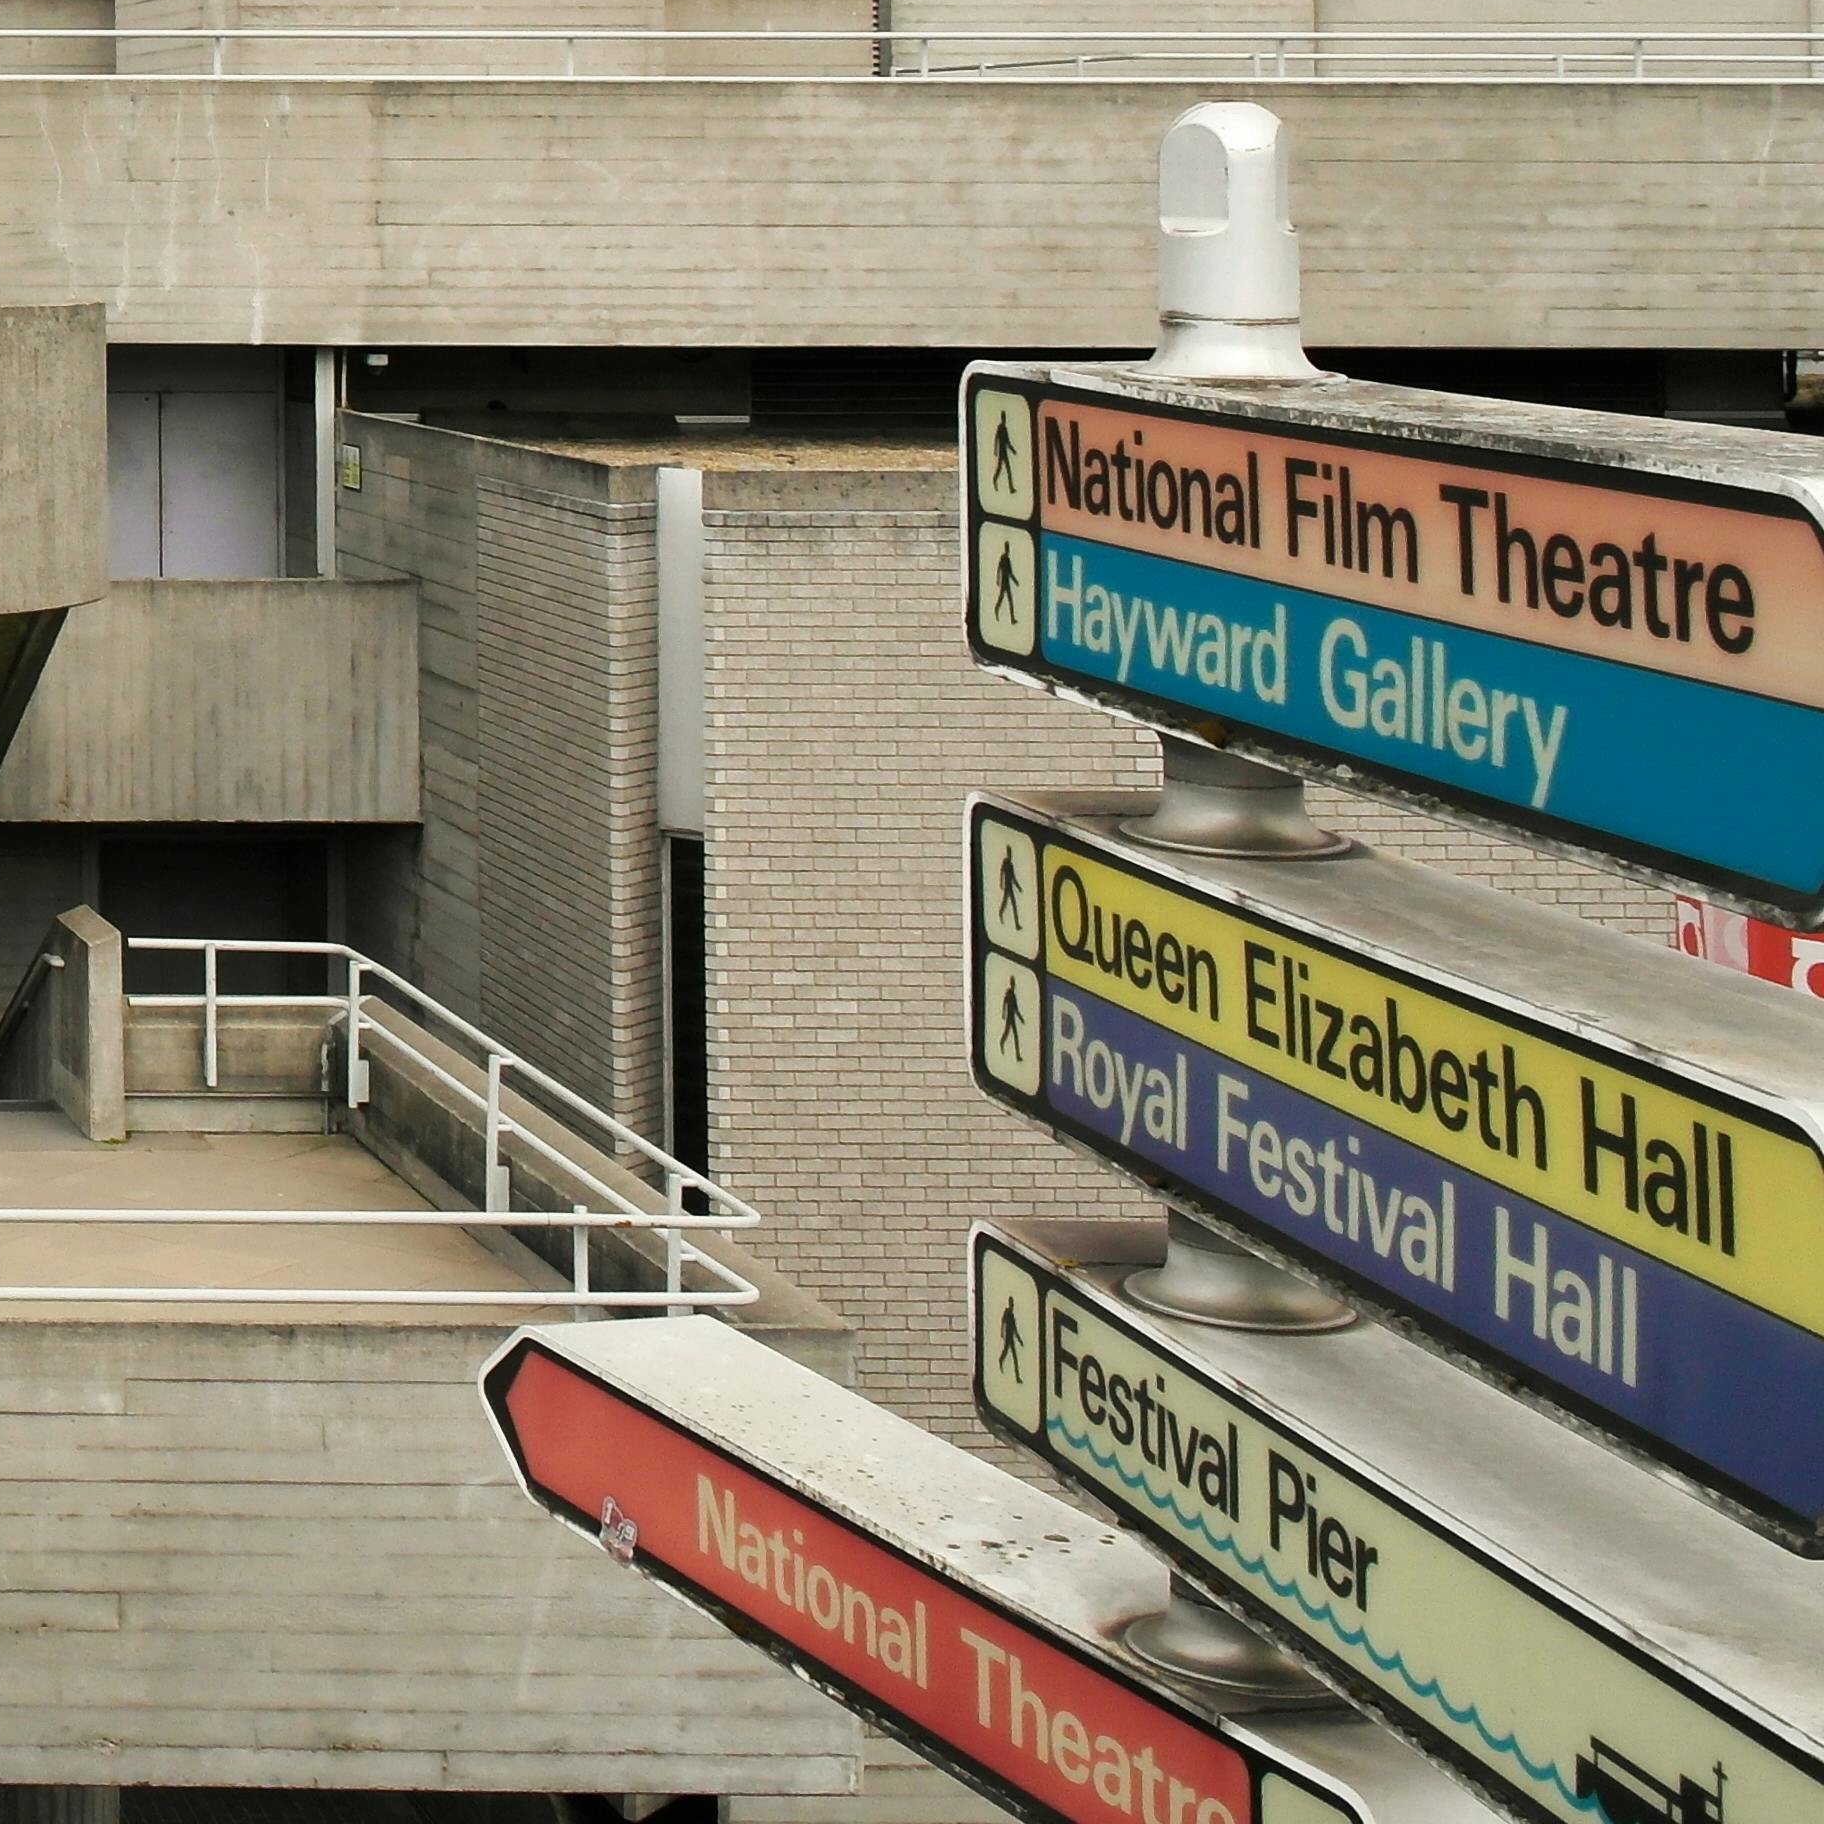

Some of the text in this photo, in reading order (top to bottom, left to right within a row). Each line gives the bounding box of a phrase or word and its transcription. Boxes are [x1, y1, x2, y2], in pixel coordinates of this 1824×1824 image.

[1045, 416, 1754, 654] National Film Theatre
[1047, 550, 1568, 809] Hayward Gallery
[1052, 865, 1219, 1022] Queen
[1244, 940, 1547, 1172] Elizabeth
[1580, 1075, 1736, 1258] Hall
[1052, 994, 1637, 1389] Royal Festival Hall
[696, 1473, 929, 1688] National
[1052, 1307, 1378, 1613] Festival Pier
